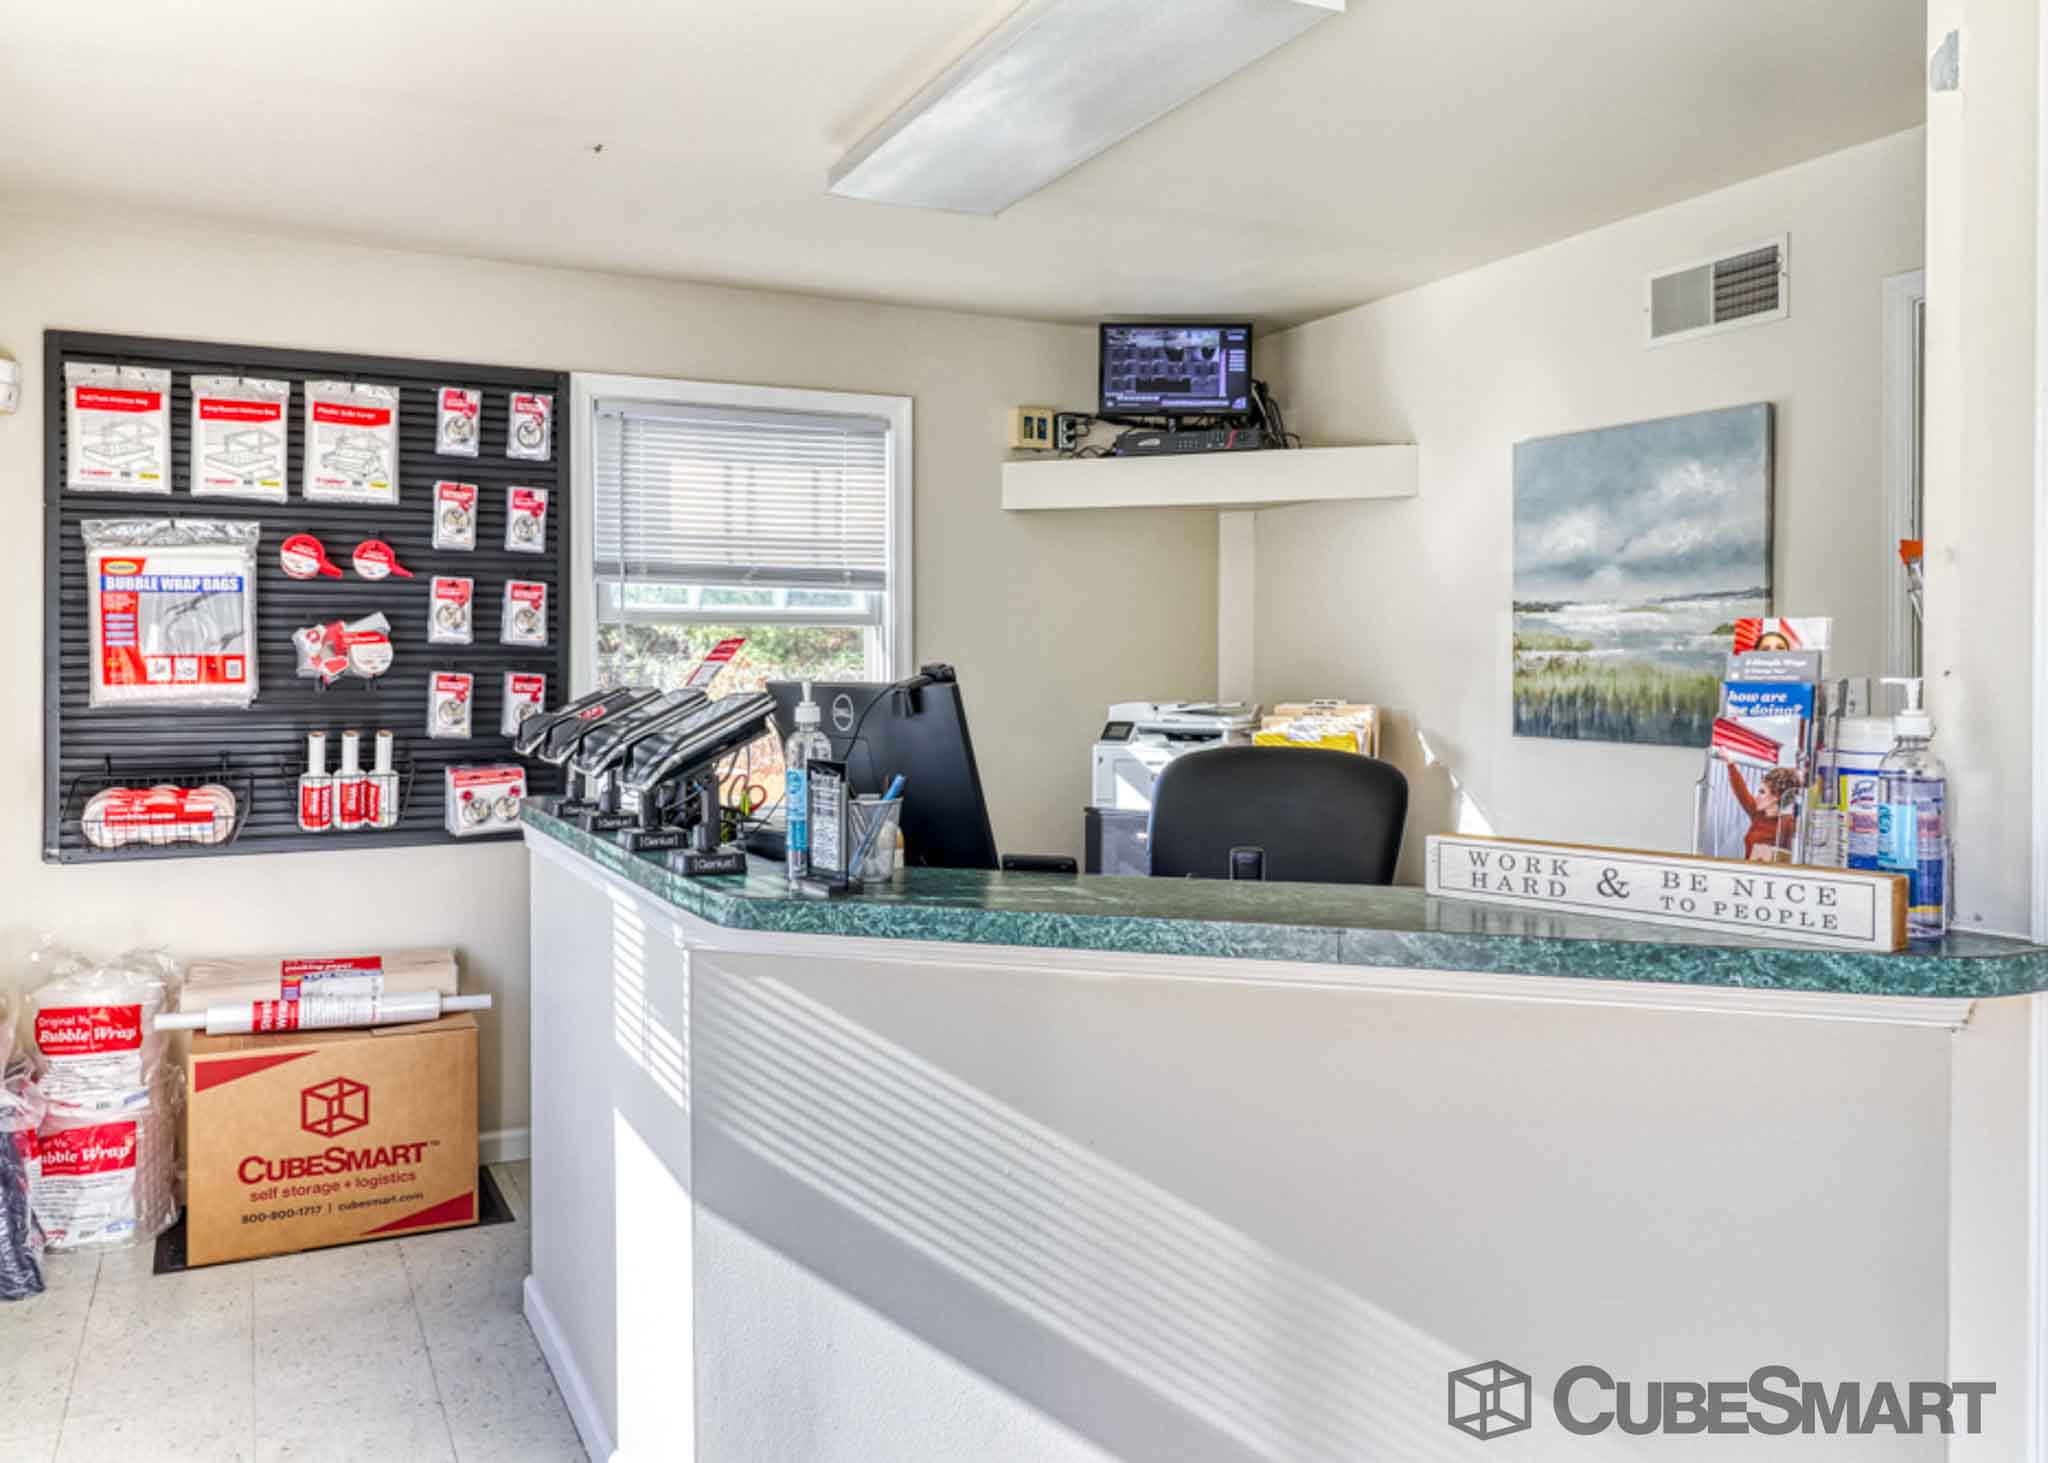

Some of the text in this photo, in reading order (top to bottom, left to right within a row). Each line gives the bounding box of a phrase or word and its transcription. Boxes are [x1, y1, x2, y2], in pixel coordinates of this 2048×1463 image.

[105, 575, 239, 591] BUBBLE WRAP BAGS
[1728, 690, 1788, 702] how are
[1749, 703, 1804, 717] doing?
[1468, 850, 1570, 877] WORK
[1471, 872, 1567, 898] HARD
[1596, 867, 1631, 899] &
[1662, 870, 1838, 907] BE NICE
[1659, 896, 1839, 930] TO PEOPLE
[37, 1015, 75, 1029] Original
[39, 1025, 138, 1043] Bubble Wrap
[81, 1144, 130, 1162] Wrap
[250, 1188, 277, 1202] self
[282, 1181, 341, 1199] storage
[355, 1170, 417, 1190] logistics
[241, 1191, 424, 1225] 800-800-1717 cubesmart.com
